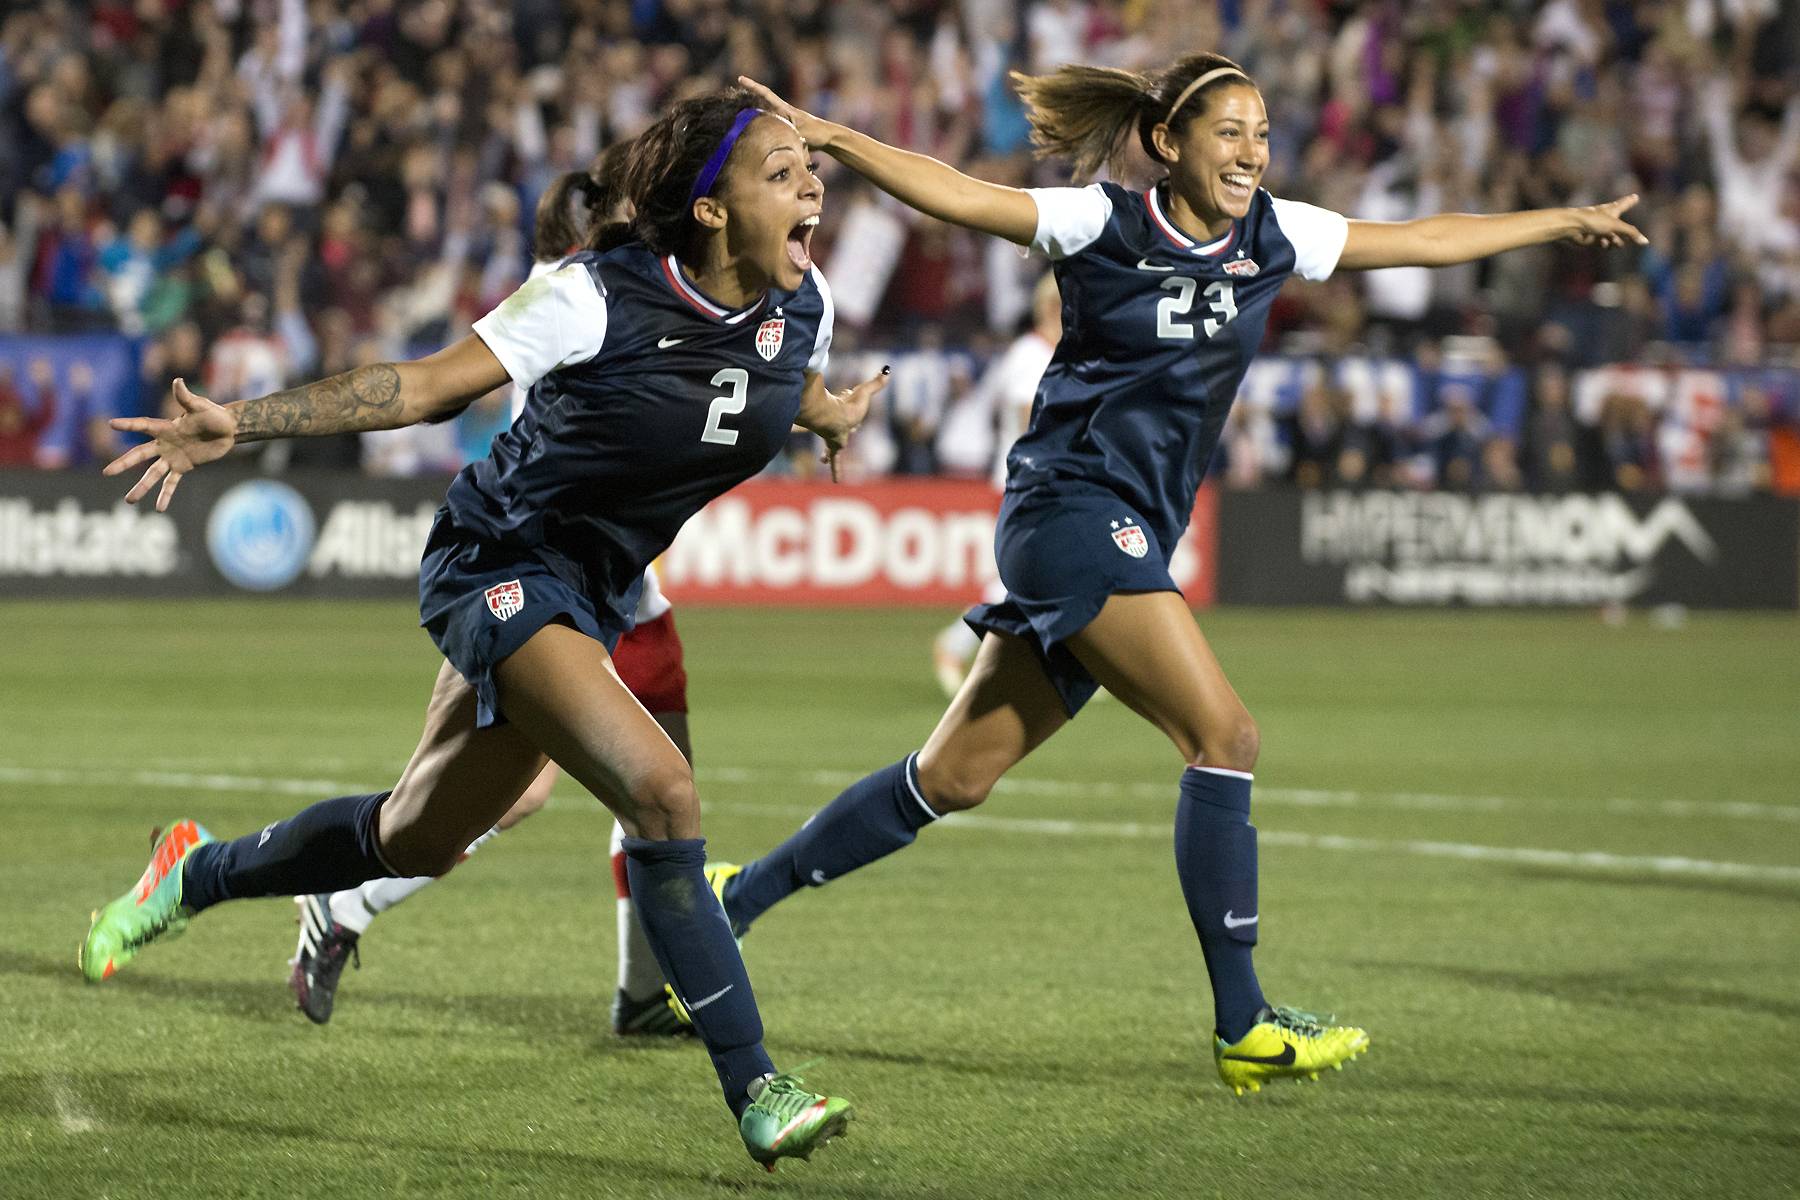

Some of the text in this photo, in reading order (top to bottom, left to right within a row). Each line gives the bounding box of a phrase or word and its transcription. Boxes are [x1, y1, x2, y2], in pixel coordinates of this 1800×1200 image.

[1157, 276, 1238, 338] 23
[701, 368, 749, 446] 2
[0, 497, 179, 576] llstate
[308, 500, 437, 577] Allst
